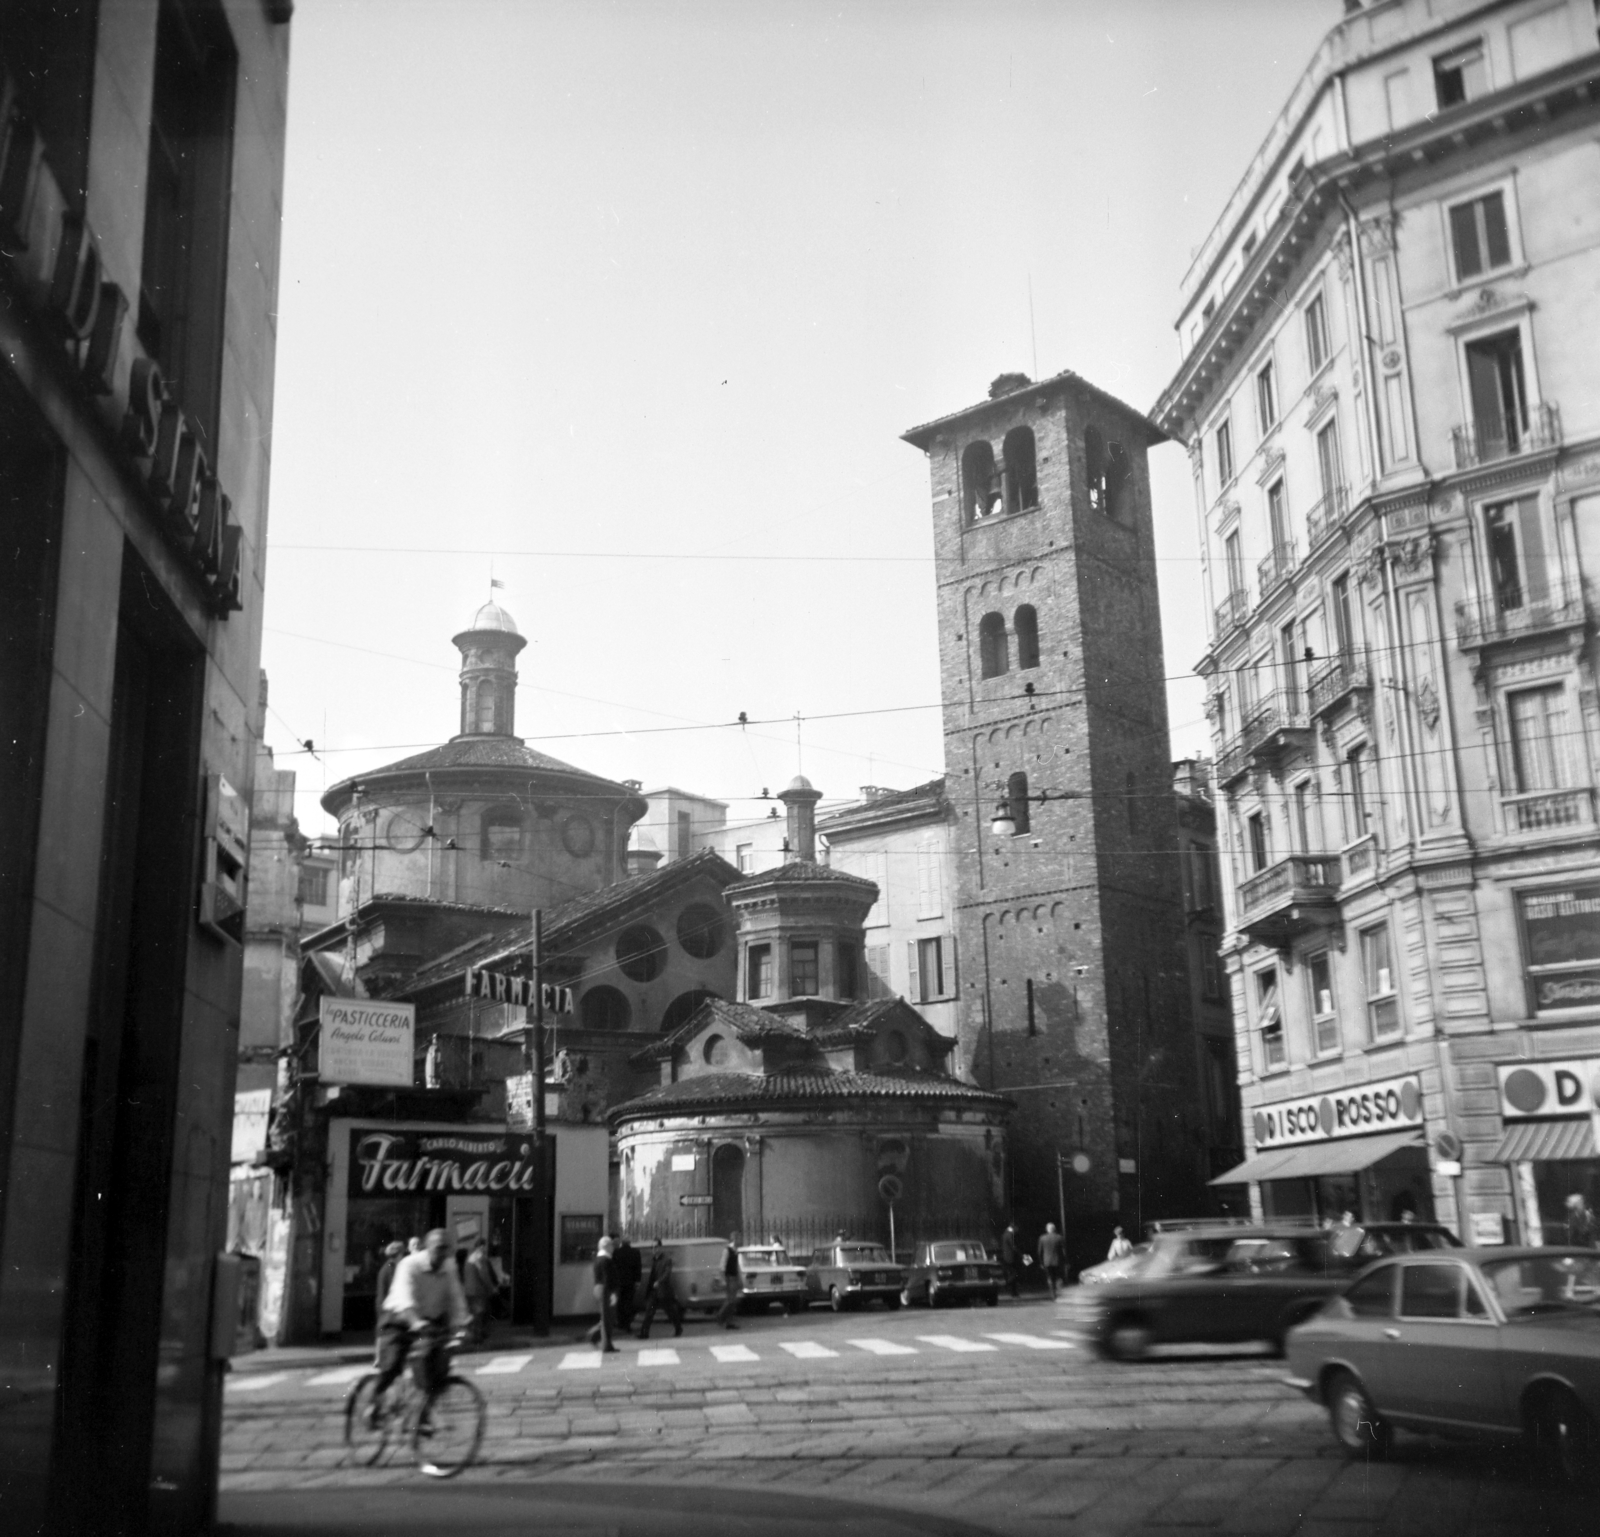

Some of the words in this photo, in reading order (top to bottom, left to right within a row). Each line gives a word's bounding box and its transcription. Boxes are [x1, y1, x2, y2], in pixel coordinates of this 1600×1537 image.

[124, 356, 244, 612] SIENA
[465, 967, 575, 1014] FARMACIA
[332, 1009, 410, 1030] PASTICCERIA
[1555, 1069, 1583, 1107] D
[1267, 1104, 1319, 1140] DISCO
[1335, 1088, 1399, 1129] ROSSO
[426, 1137, 456, 1150] CARLO
[457, 1139, 496, 1154] ALBERTO
